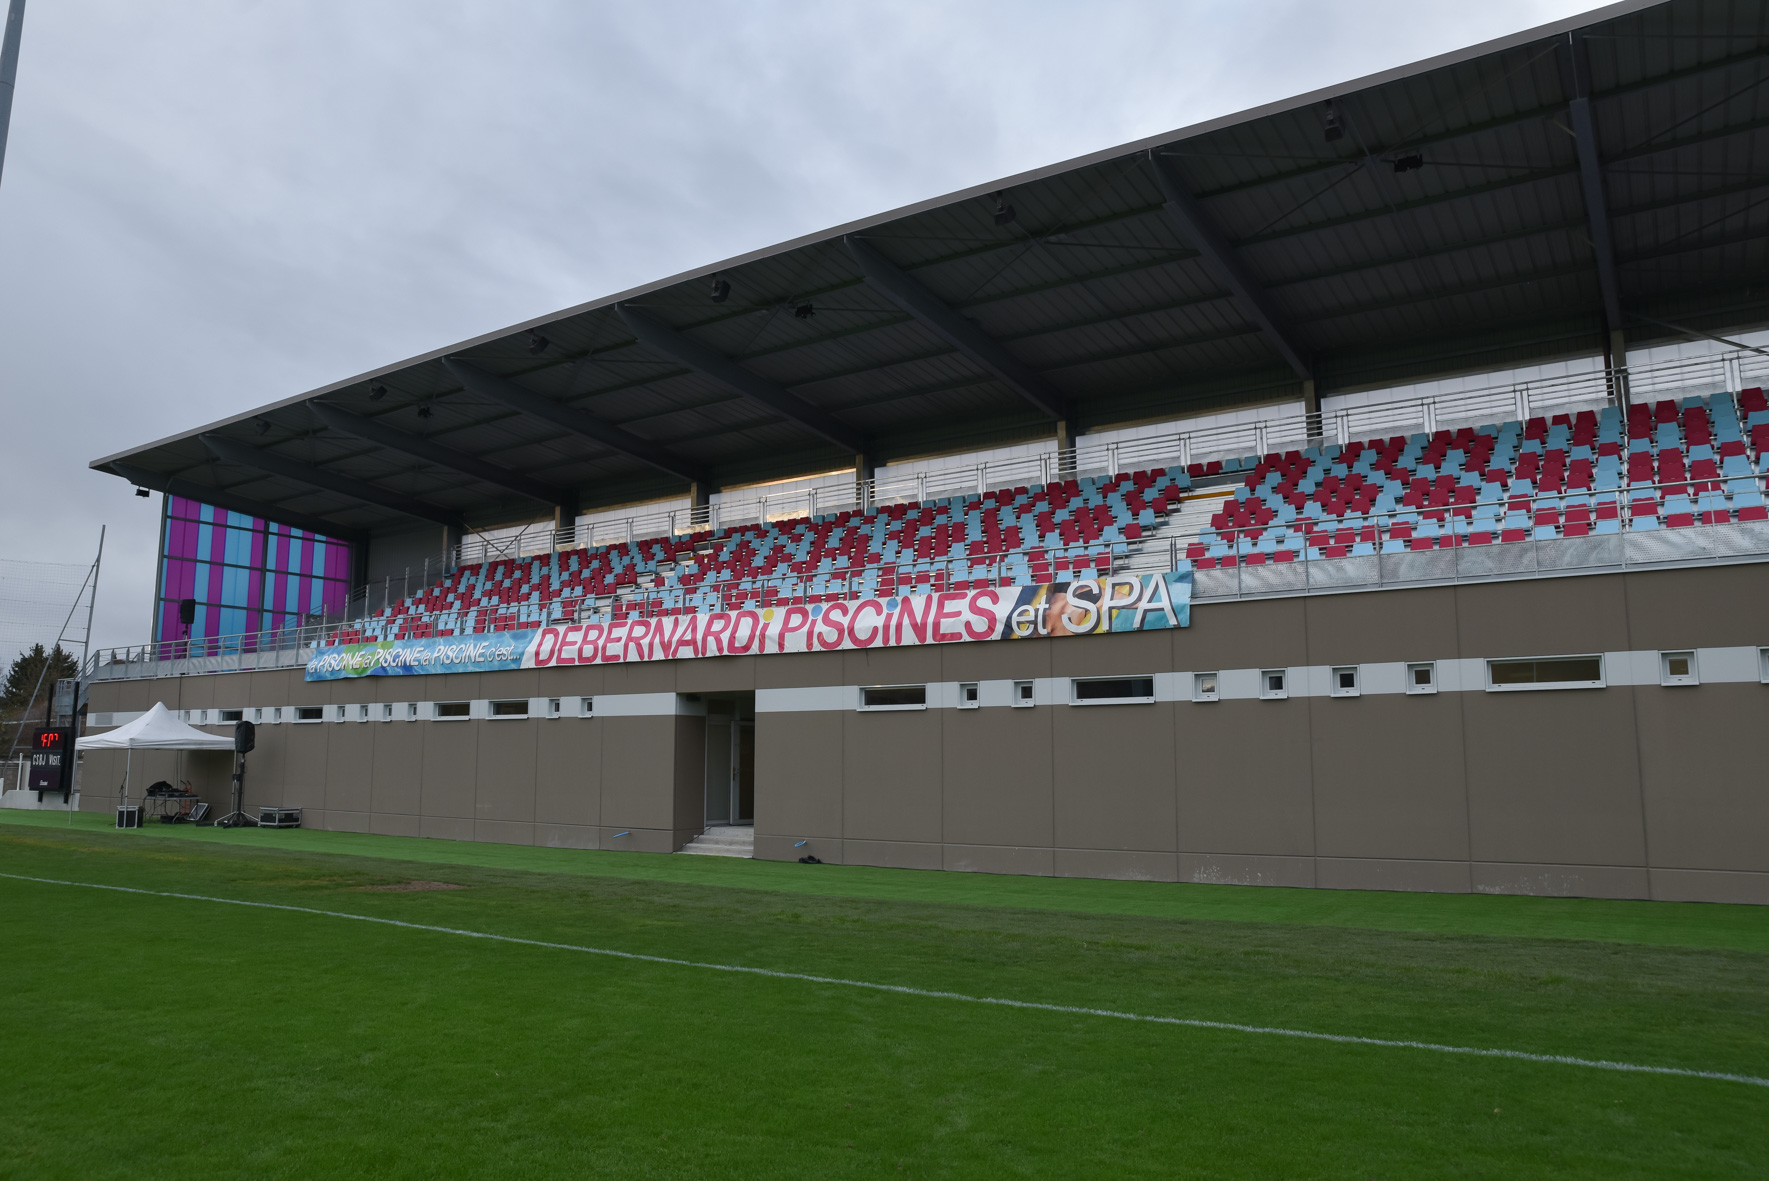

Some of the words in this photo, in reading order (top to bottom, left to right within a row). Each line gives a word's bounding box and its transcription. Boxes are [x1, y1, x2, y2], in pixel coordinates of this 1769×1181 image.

[1011, 599, 1051, 637] et
[1061, 573, 1178, 633] SPA
[308, 658, 317, 673] la
[317, 651, 365, 672] PISCINE
[370, 647, 424, 667] PISCINE
[421, 649, 431, 665] la
[431, 642, 489, 664] PISCINE
